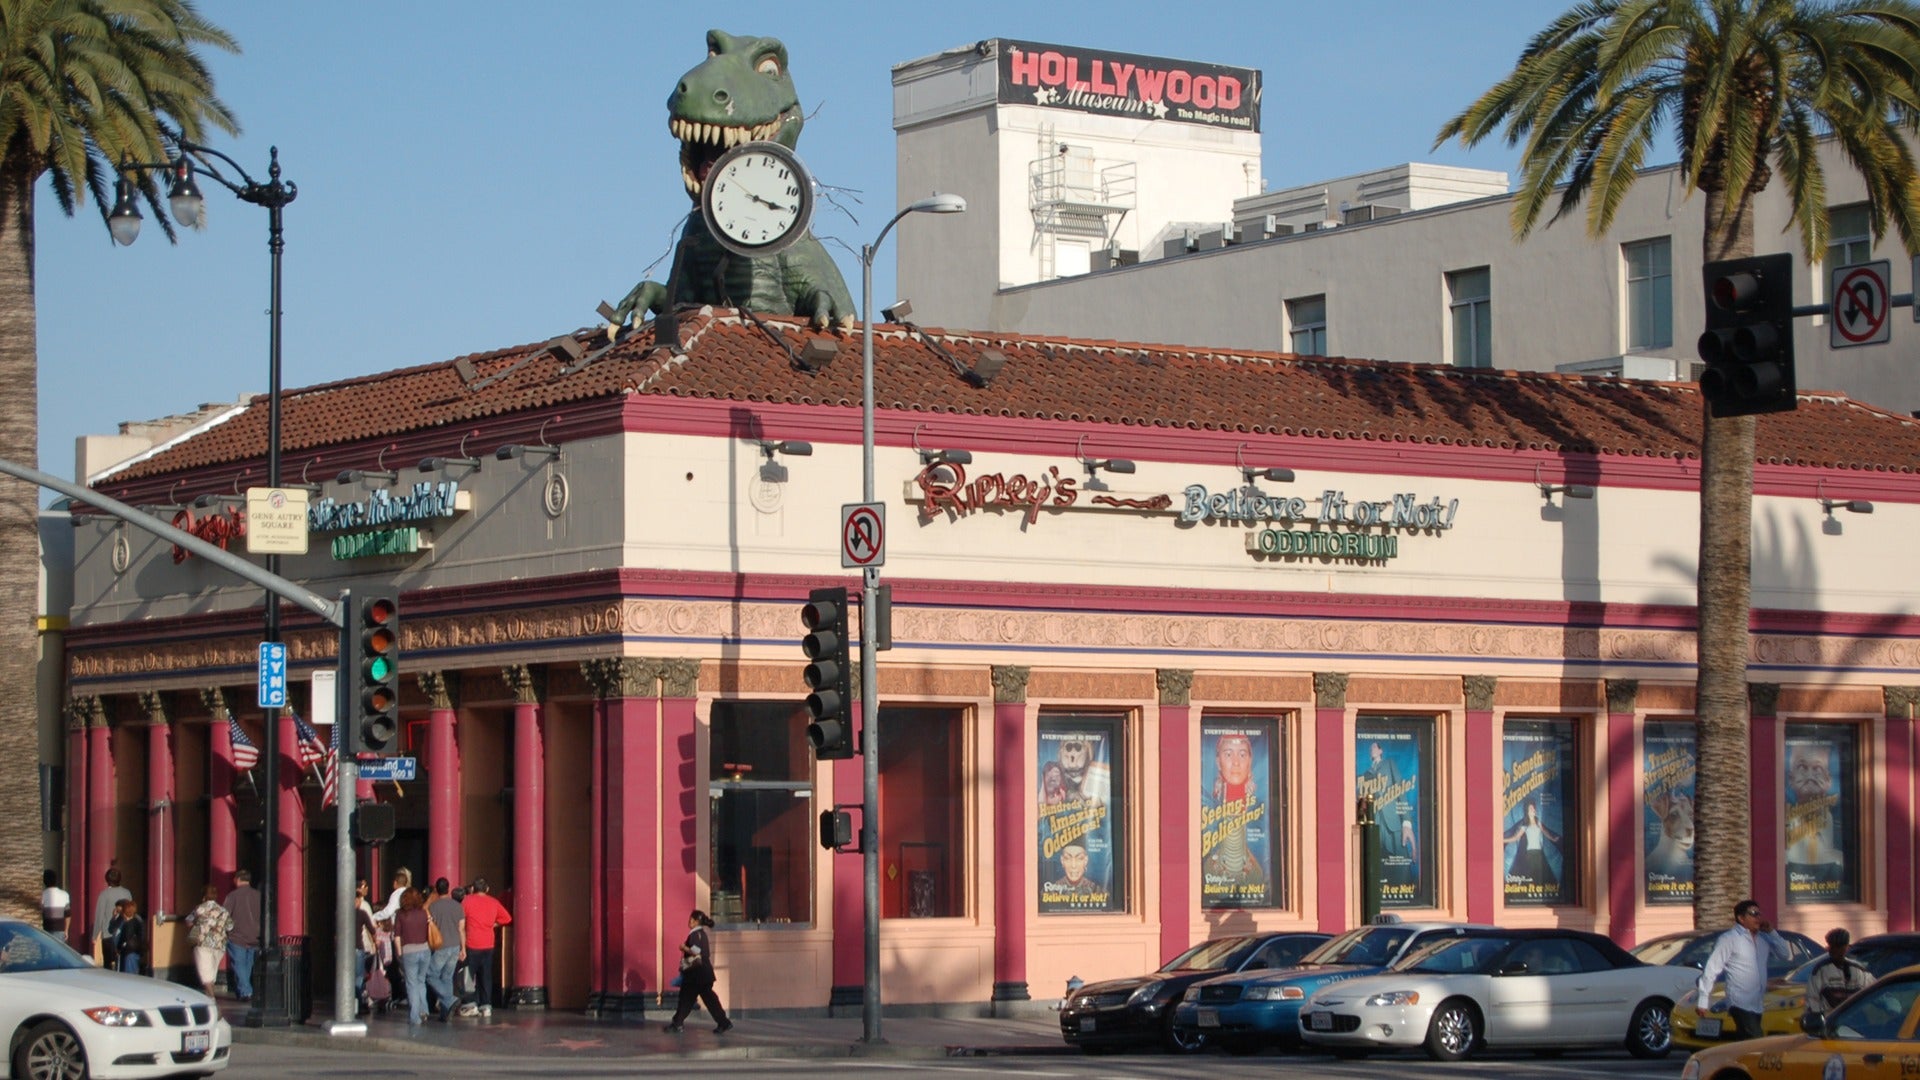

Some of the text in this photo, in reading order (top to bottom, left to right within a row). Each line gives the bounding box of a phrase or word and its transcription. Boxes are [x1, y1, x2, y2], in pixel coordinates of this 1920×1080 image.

[1011, 50, 1241, 110] HOLLYWOOD
[1056, 82, 1145, 114] Museum
[1177, 109, 1193, 119] The
[1194, 111, 1220, 124] Magic
[1221, 115, 1229, 124] is
[762, 157, 776, 169] 12
[778, 169, 791, 180] 11
[786, 186, 799, 197] 10
[788, 204, 797, 215] 9
[742, 229, 751, 240] 6
[919, 461, 1078, 525] Ripley's
[1181, 484, 1459, 528] Believe It or Not!
[278, 513, 303, 521] AUTRY
[1258, 529, 1398, 559] ODDITORIUM
[270, 646, 283, 704] SYNC
[1050, 804, 1106, 834] Amazing
[1202, 795, 1257, 830] Seeing is
[1043, 816, 1101, 859] Oddities!
[1202, 803, 1264, 858] Believing!
